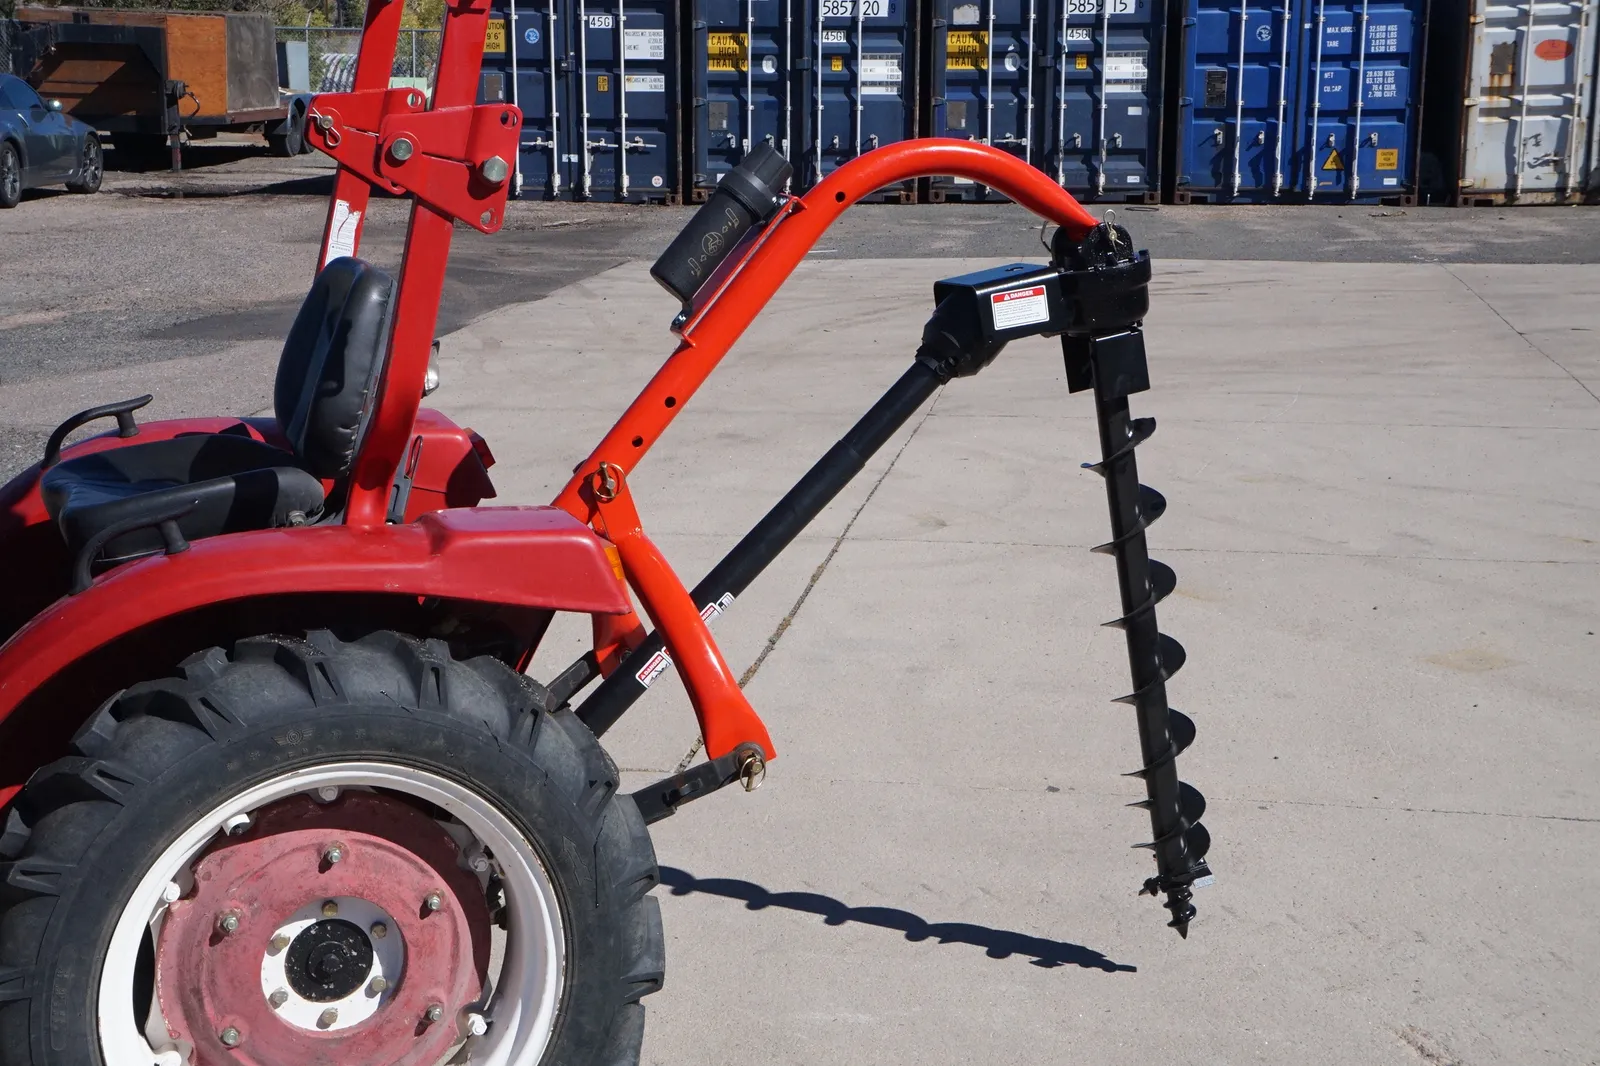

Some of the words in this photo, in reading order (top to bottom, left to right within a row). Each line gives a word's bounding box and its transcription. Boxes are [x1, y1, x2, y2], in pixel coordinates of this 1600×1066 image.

[487, 22, 506, 30] UTION
[711, 35, 746, 45] CAUTION
[950, 34, 986, 44] CAUTION
[718, 47, 737, 57] HIGH
[958, 45, 977, 55] HIGH
[711, 58, 746, 68] TRAILER
[950, 56, 986, 67] TRAILER
[1010, 290, 1034, 298] DANGER
[644, 655, 663, 675] DANGER
